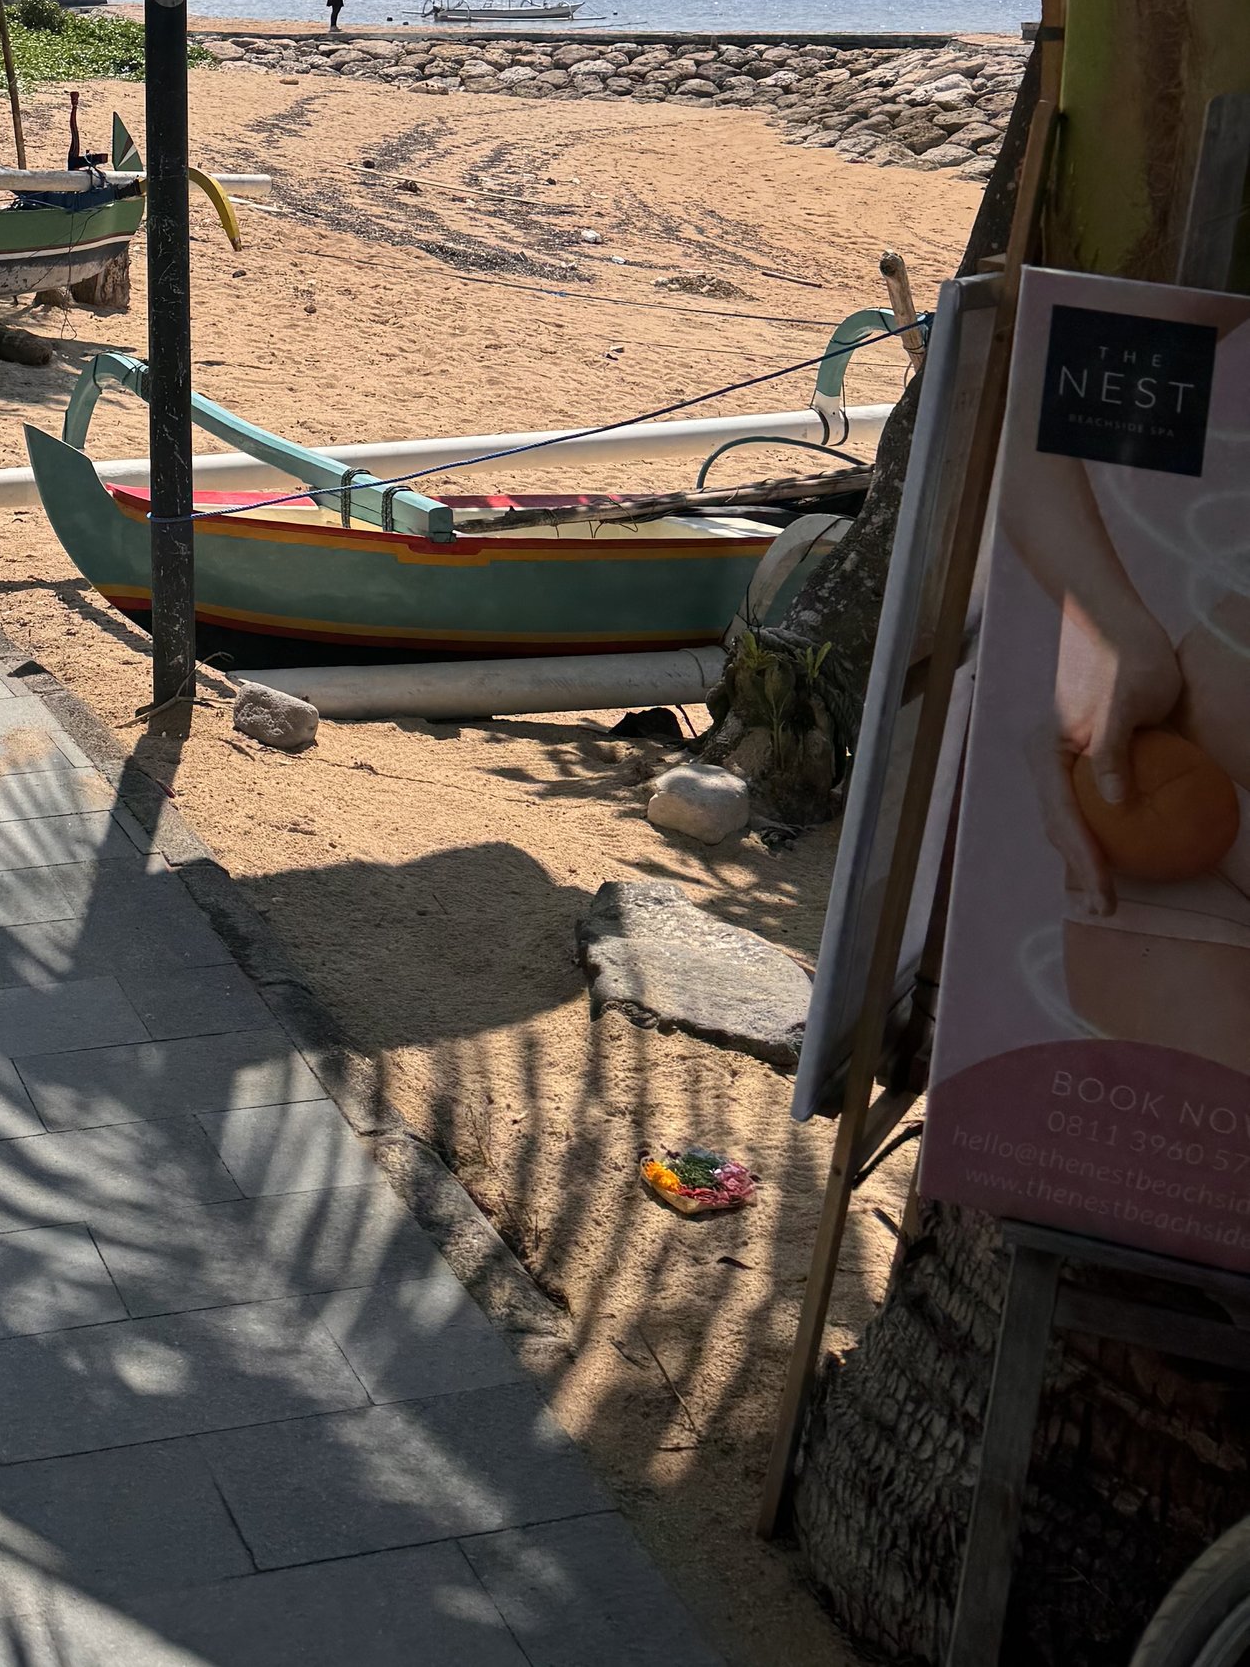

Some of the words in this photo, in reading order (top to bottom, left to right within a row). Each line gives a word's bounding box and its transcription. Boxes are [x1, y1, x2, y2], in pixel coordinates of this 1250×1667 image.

[1098, 346, 1163, 368] THE
[1059, 365, 1196, 414] NEST
[1068, 412, 1145, 434] BEACHSIDE
[1149, 426, 1175, 438] SPA
[1051, 1070, 1165, 1119] BOOK
[1048, 1110, 1119, 1147] 0811
[1128, 1130, 1204, 1166] 3960
